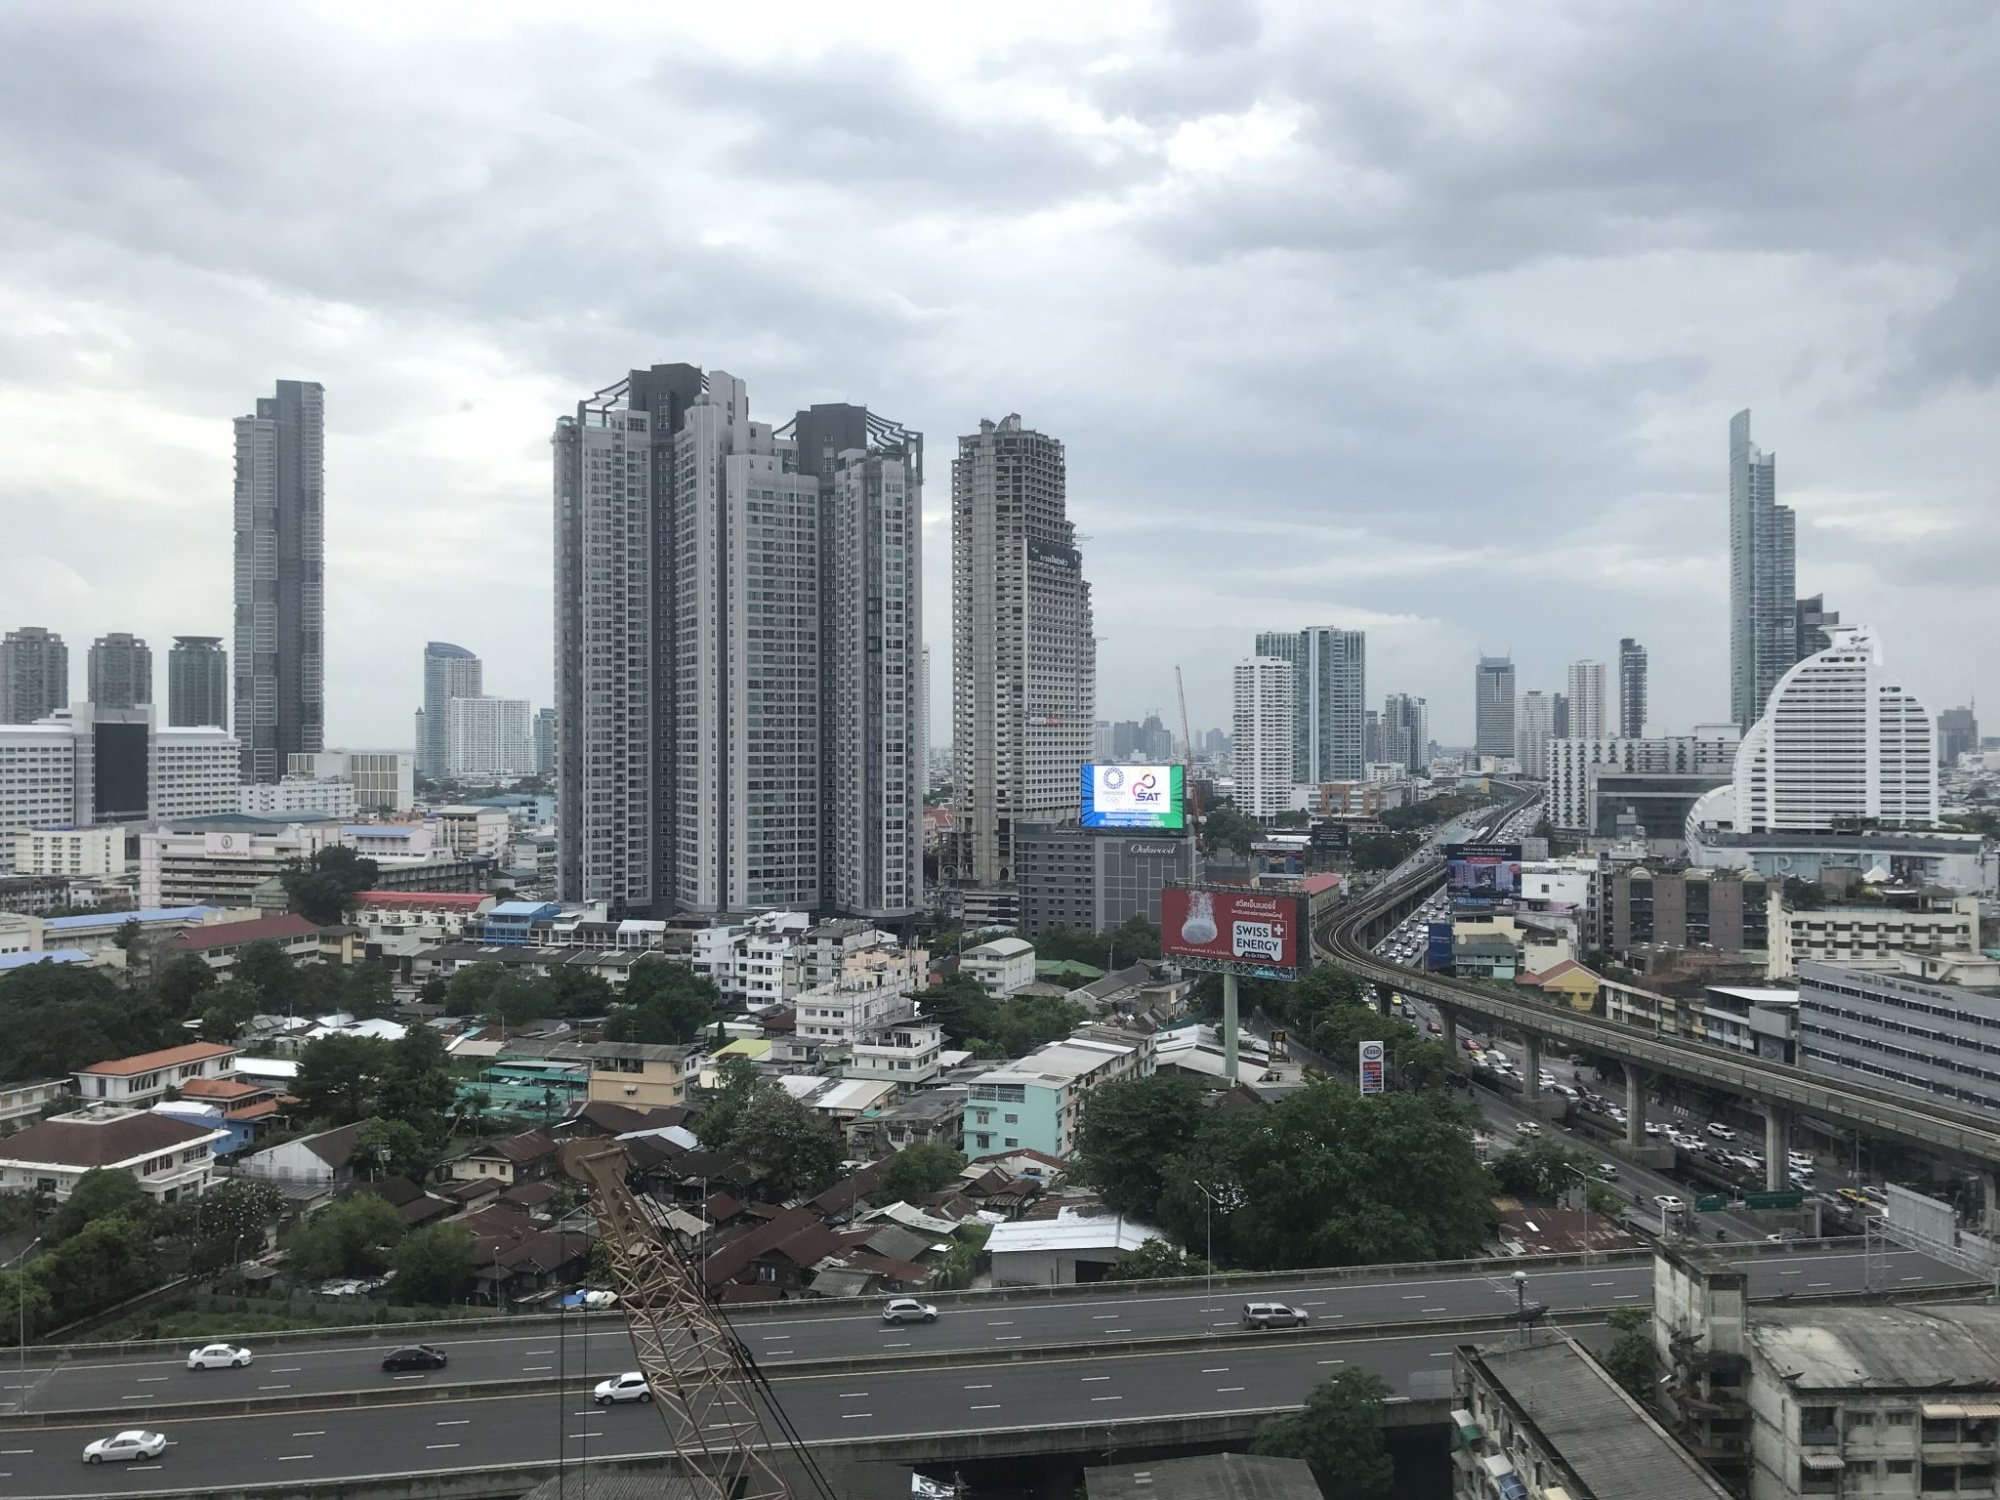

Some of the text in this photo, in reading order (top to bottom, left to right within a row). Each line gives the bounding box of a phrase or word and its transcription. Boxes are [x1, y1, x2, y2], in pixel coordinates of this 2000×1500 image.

[1136, 793, 1161, 801] SAT
[1130, 843, 1176, 854] Oakwood
[1236, 925, 1269, 937] SWISS
[1236, 938, 1279, 951] ENERGY
